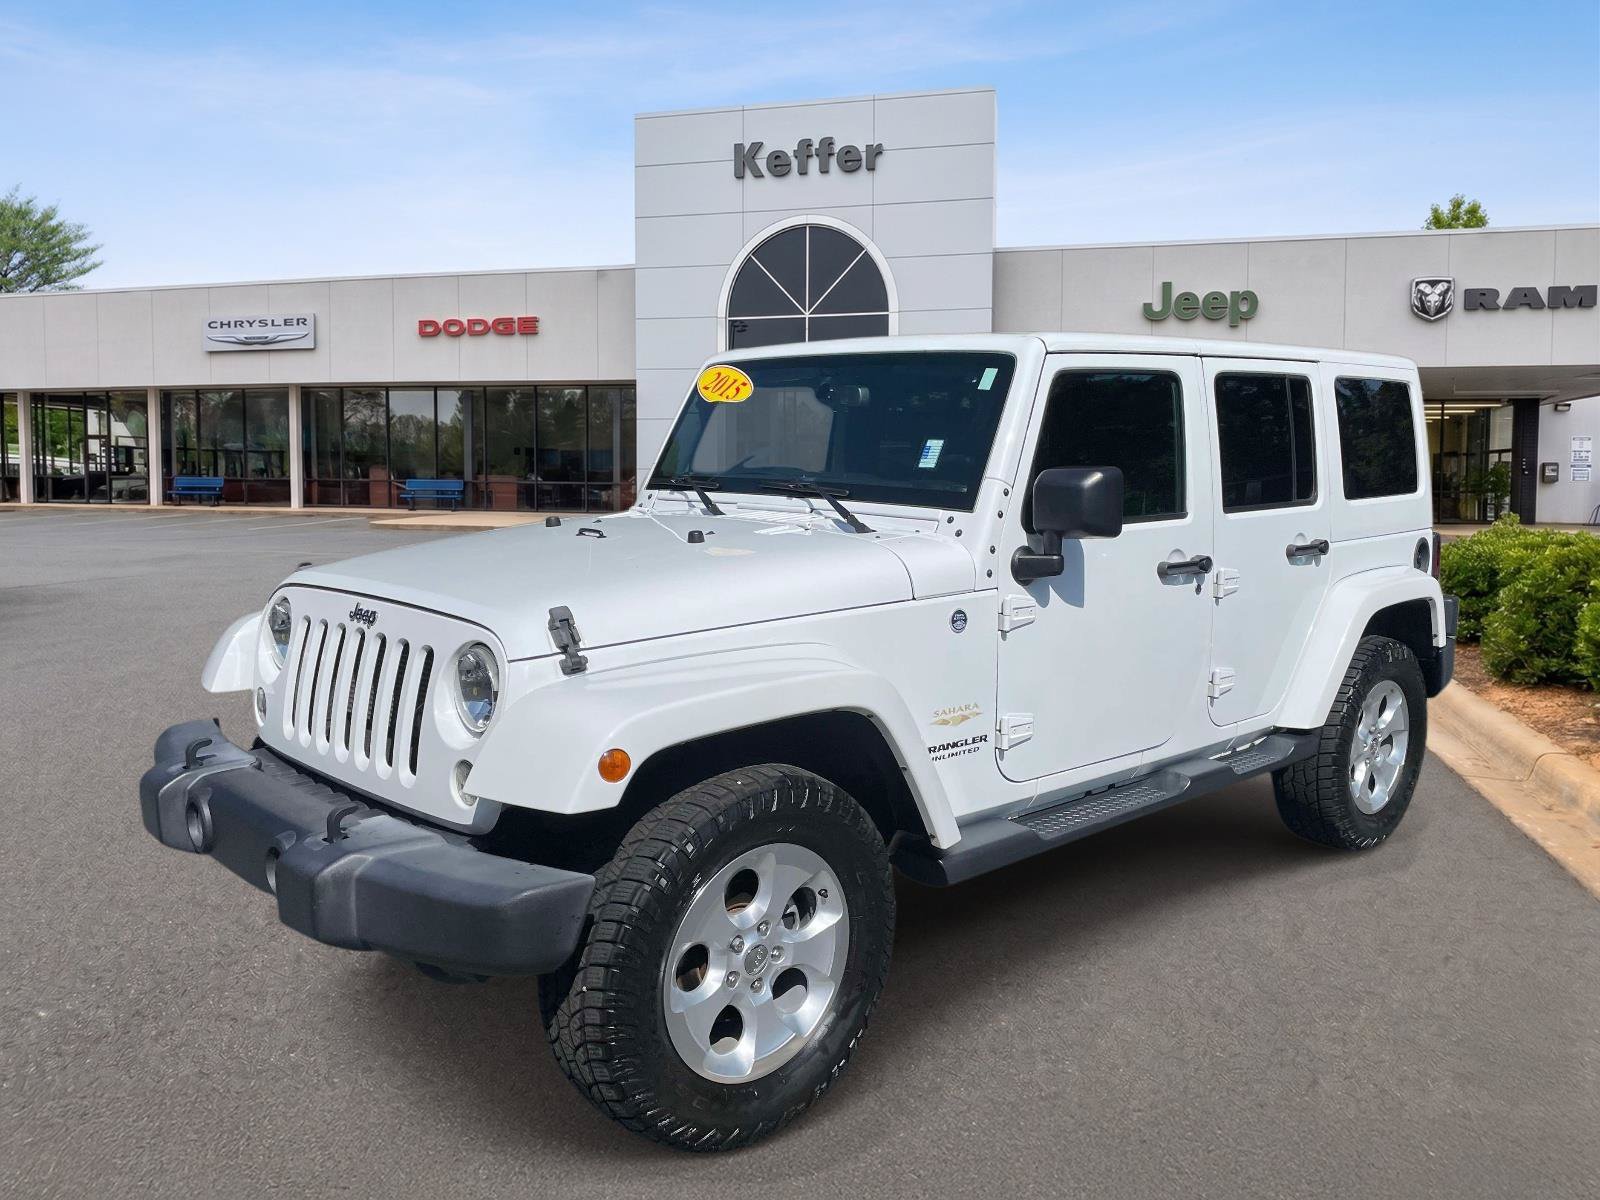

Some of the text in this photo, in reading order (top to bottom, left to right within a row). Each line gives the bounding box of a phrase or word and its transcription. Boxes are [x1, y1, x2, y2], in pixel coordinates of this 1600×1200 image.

[734, 137, 883, 179] Keffer
[1143, 281, 1259, 328] Jeep
[1464, 285, 1598, 311] RAM
[207, 317, 308, 330] CHRYSLER
[418, 316, 540, 338] DODGE
[702, 371, 748, 400] 2015
[349, 601, 378, 630] Jeep
[933, 702, 980, 718] SAHARA
[928, 734, 988, 754] RANGLER
